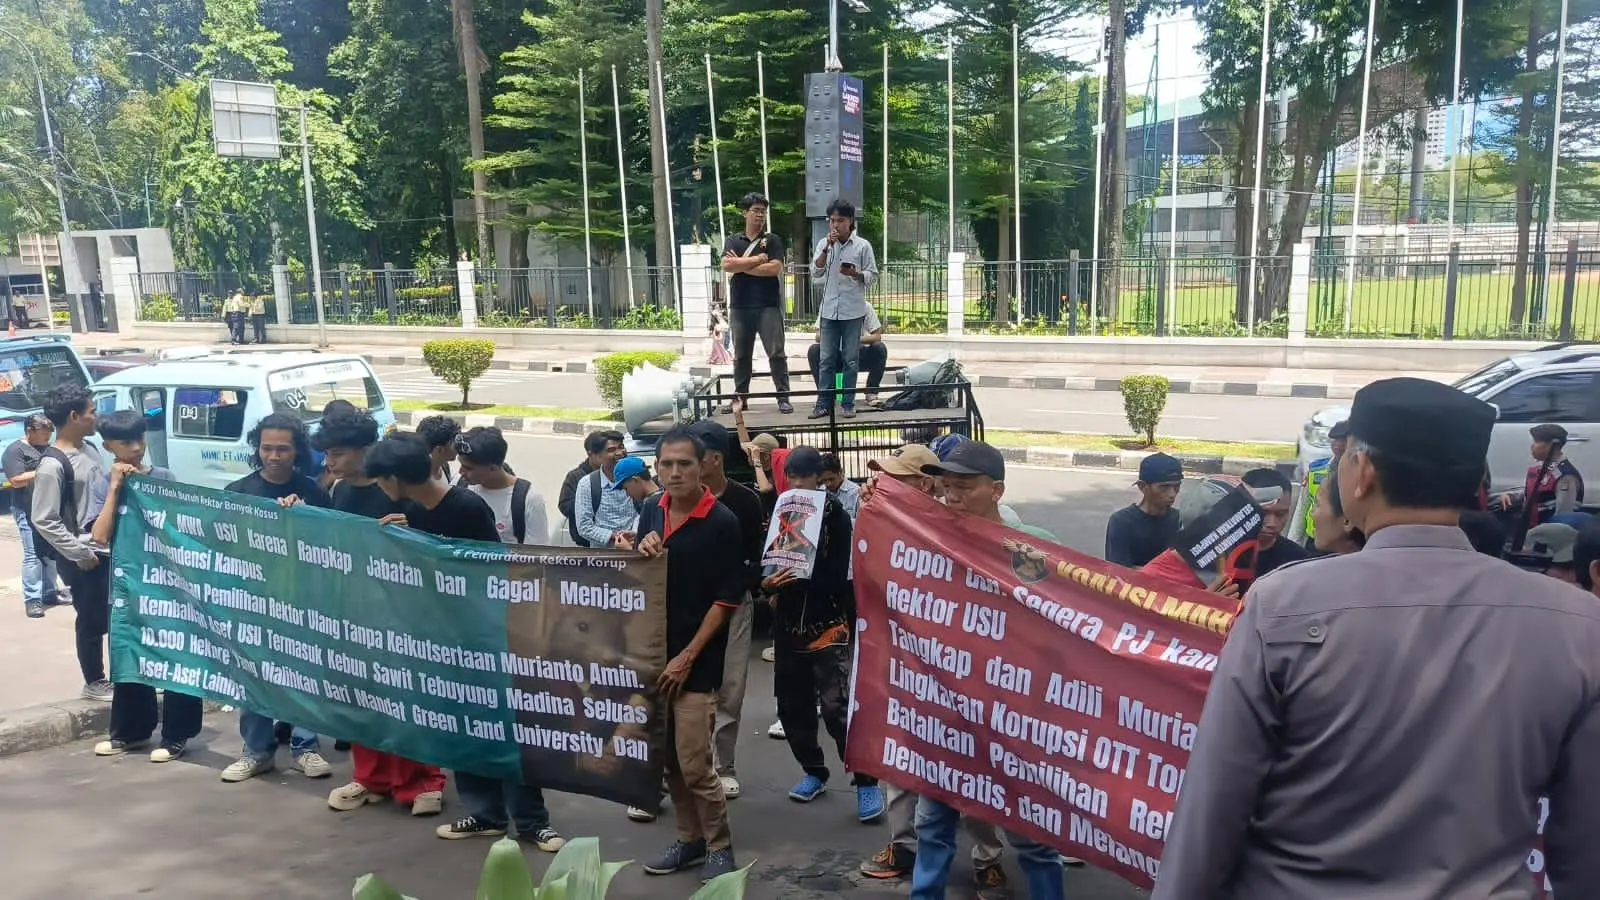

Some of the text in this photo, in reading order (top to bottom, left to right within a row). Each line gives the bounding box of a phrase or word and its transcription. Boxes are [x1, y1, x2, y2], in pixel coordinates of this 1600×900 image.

[285, 388, 308, 408] 04
[141, 481, 156, 495] USU
[158, 486, 177, 498] Tidak
[200, 495, 223, 509] Rektor
[224, 501, 252, 516] Banyak
[254, 507, 279, 520] Kasus
[176, 512, 205, 537] MWA
[213, 521, 239, 543] USU
[247, 527, 288, 556] Karena
[297, 540, 352, 575] Rangkap
[366, 555, 423, 588] Jabatan
[434, 570, 467, 597] Dan
[486, 575, 540, 604] Gagal
[560, 580, 646, 613] Menjaga
[214, 551, 266, 582] Kampus.
[464, 550, 535, 564] Penjarakan
[539, 555, 582, 567] Rektor
[587, 557, 627, 571] Korup
[890, 539, 954, 582] Copot
[1112, 622, 1155, 655] PJ
[203, 583, 267, 616] Pemilihan
[268, 597, 305, 627] Rektor
[307, 608, 340, 640] Ulang
[342, 619, 383, 650] Tanpa
[387, 630, 496, 673] Keikutsertaan
[501, 651, 584, 683] Murianto
[589, 662, 645, 689] Amin.
[886, 581, 1007, 641] Rektor USU
[139, 656, 201, 688] Aset-Aset
[237, 621, 262, 647] USU
[266, 628, 324, 667] Termasuk
[327, 648, 368, 680] Kebun
[372, 661, 414, 692] Sawit
[418, 671, 499, 710] Tebuyung
[505, 687, 576, 717] Madina
[583, 696, 648, 724] Seluas
[261, 661, 320, 696] Dialihkan
[322, 679, 351, 704] Dari
[354, 687, 407, 722] Mandat
[412, 704, 459, 734] Green
[464, 715, 506, 742] Land
[512, 722, 604, 759] University
[612, 735, 648, 762] Dan
[888, 619, 972, 680] Tangkap
[985, 655, 1032, 696] dan
[1044, 672, 1103, 718] Adili
[889, 657, 985, 725] Lingkaran
[990, 700, 1089, 762] Korupsi
[1092, 736, 1141, 780] OTT
[882, 736, 1012, 817] Demokratis,
[1018, 795, 1062, 836] dan
[887, 697, 976, 758] Batalkan
[989, 742, 1108, 819] Pemilihan
